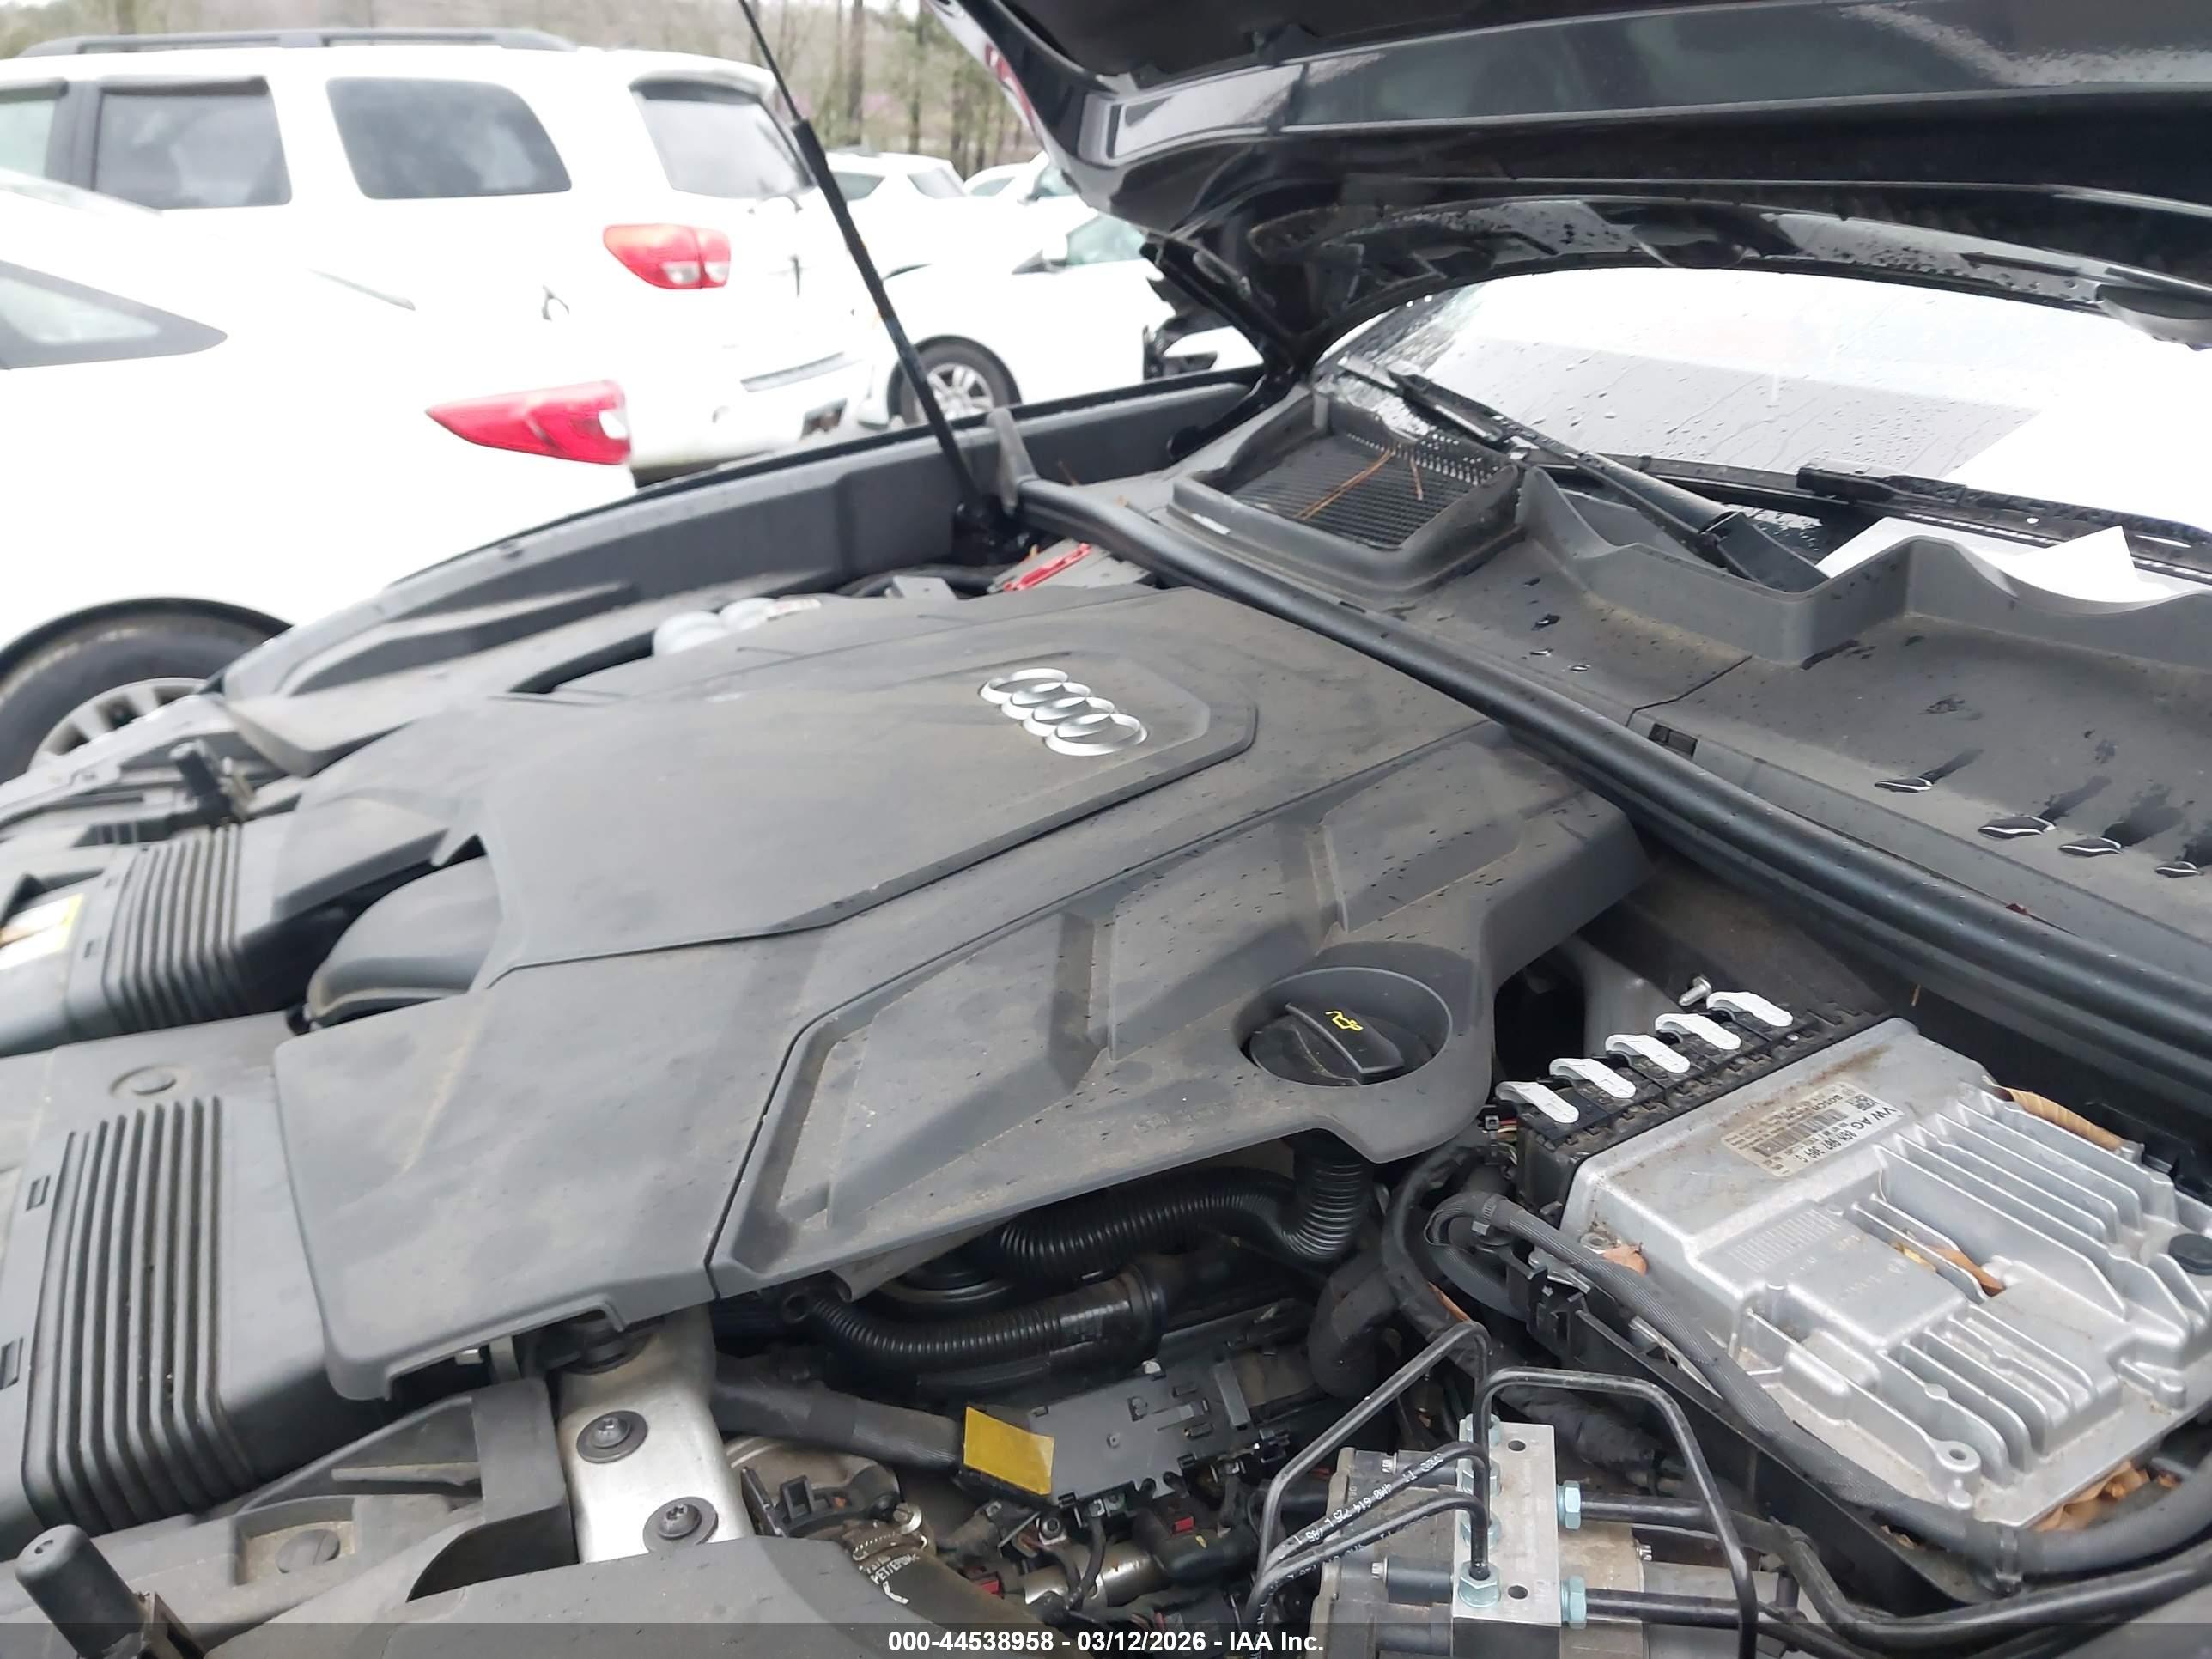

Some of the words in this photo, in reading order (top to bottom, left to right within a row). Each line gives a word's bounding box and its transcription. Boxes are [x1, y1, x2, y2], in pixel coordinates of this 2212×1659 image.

[1813, 1094, 1843, 1111] BOSCH
[1873, 1107, 1897, 1121] VW
[1850, 1116, 1872, 1130] AG
[1373, 1483, 1392, 1500] 4M0
[1352, 1497, 1373, 1514] 614
[1324, 1516, 1334, 1528] L
[1333, 1508, 1353, 1523] 725
